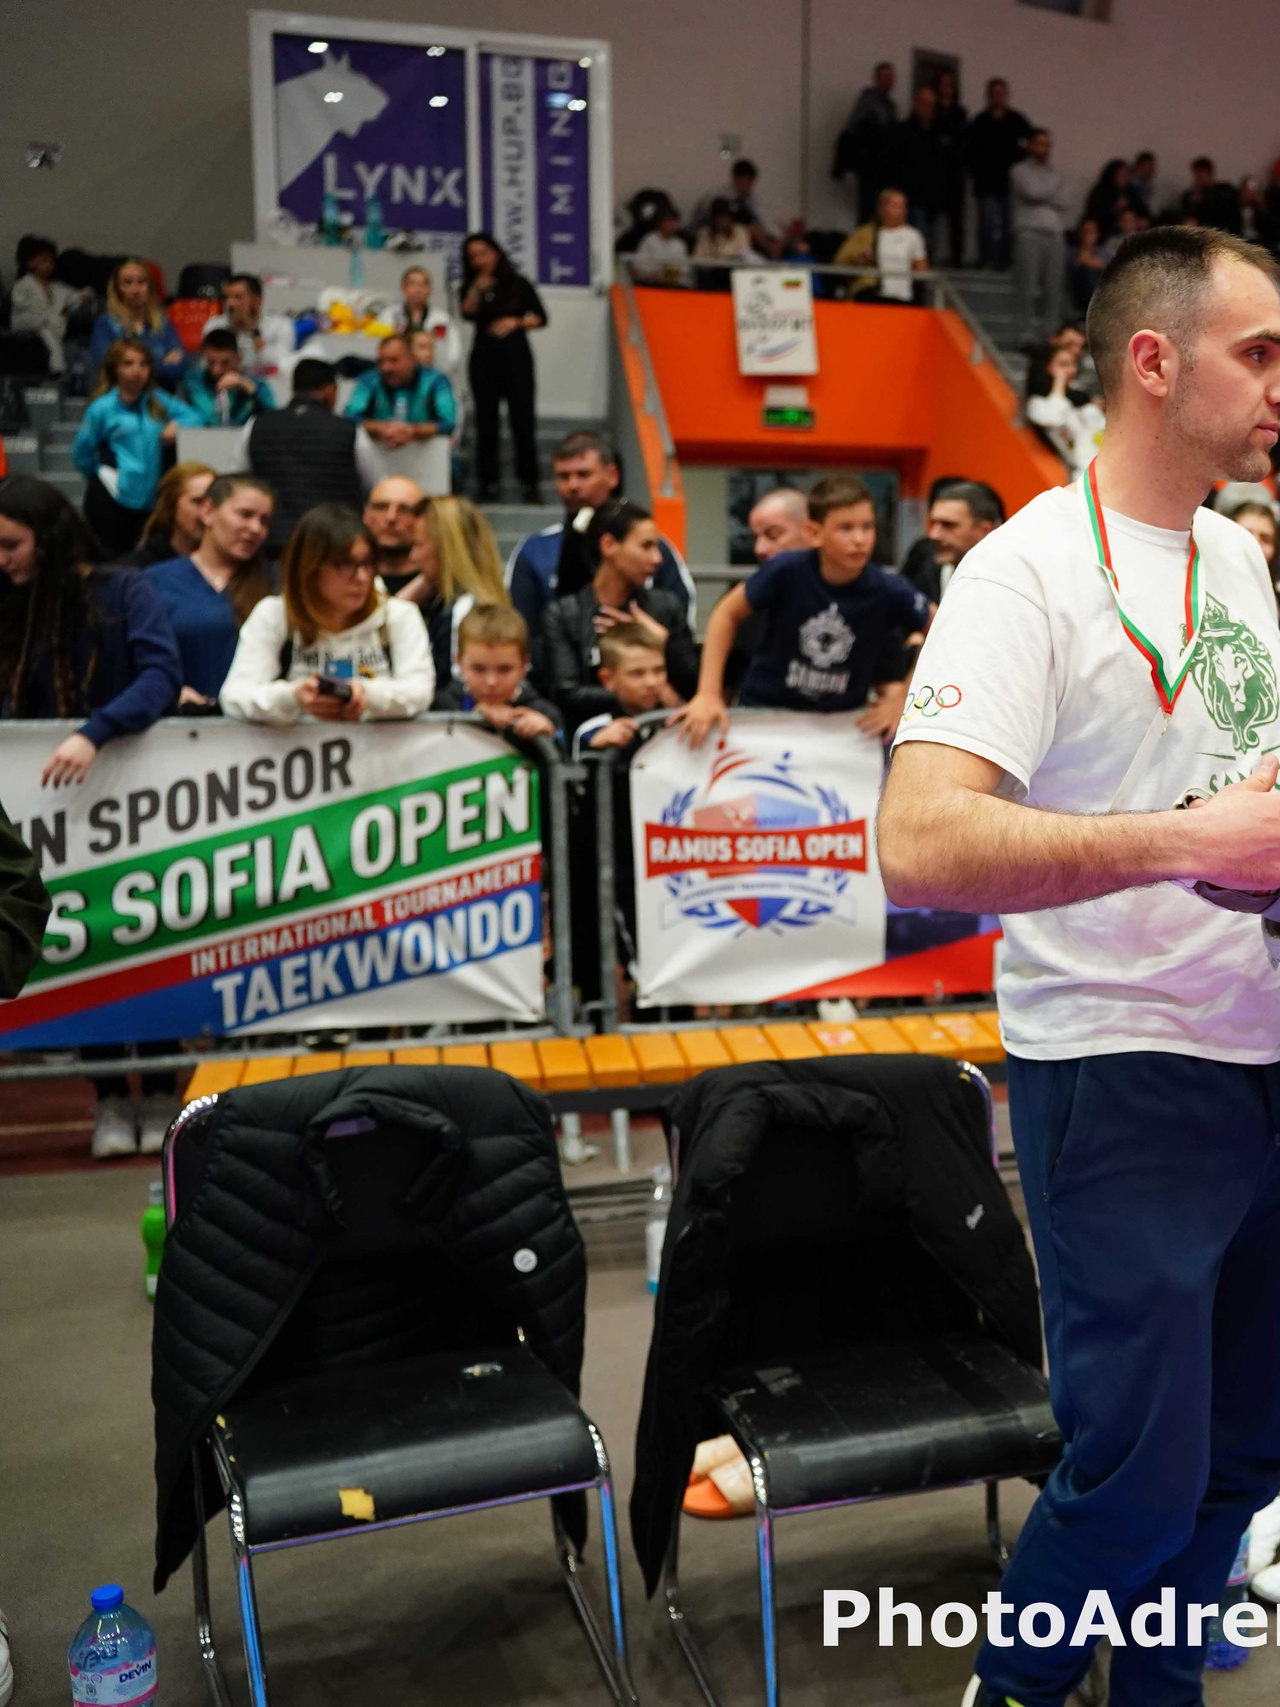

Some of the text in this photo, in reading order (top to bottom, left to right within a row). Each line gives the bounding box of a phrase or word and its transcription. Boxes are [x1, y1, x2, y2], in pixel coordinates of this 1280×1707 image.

[322, 152, 466, 208] LYNX
[88, 736, 353, 856] SPONSOR
[111, 824, 331, 944] SOFIA
[349, 766, 530, 879] OPEN
[650, 832, 864, 864] RAMUS SOFIA OPEN
[191, 857, 534, 977] INTERNATIONAL TOURNAMENT
[212, 889, 534, 1029] TAEKWONDO
[119, 1659, 152, 1683] DEVIN
